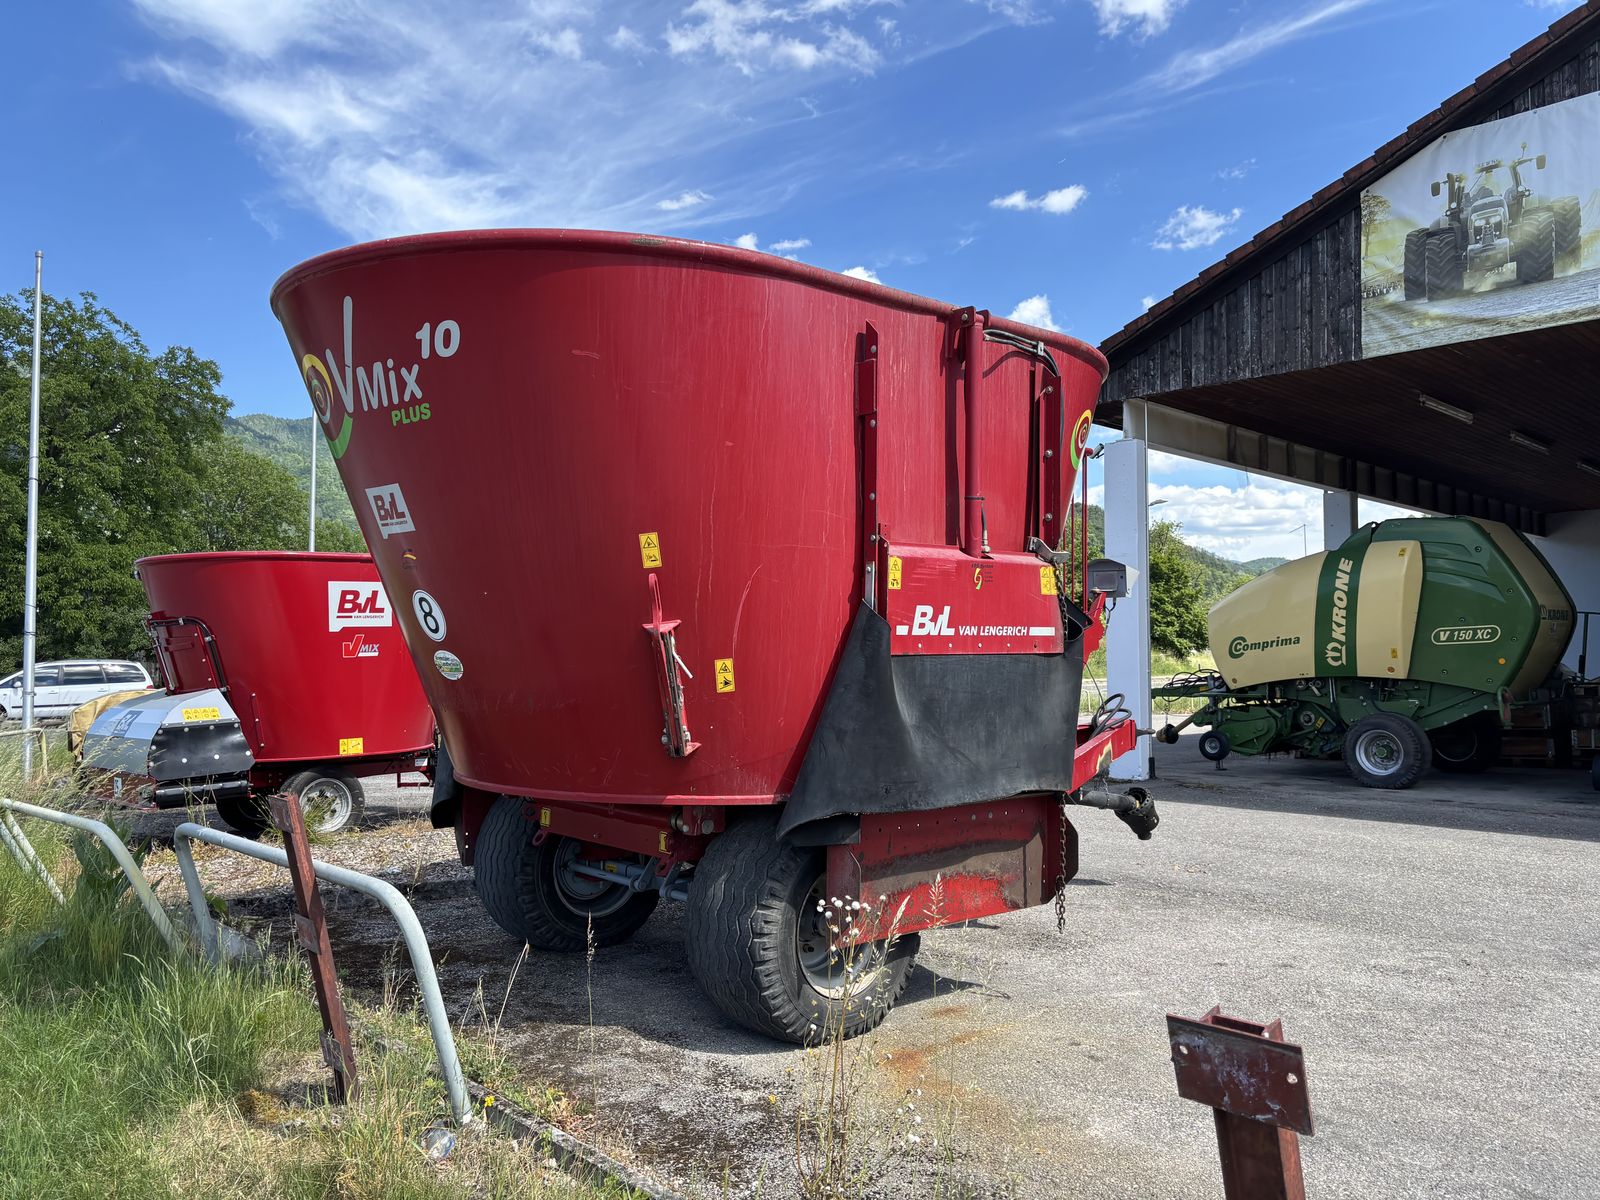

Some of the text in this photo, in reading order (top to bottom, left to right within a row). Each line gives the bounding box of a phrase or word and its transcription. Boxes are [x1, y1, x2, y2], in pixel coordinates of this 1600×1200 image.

[415, 319, 461, 360] 10
[391, 403, 431, 426] PLUS
[1332, 558, 1353, 642] KRONE
[418, 596, 439, 634] 8
[959, 626, 978, 636] VAN
[980, 626, 1027, 636] LENGERICH
[1440, 629, 1492, 641] V 150 XC
[1228, 636, 1301, 659] Comprima
